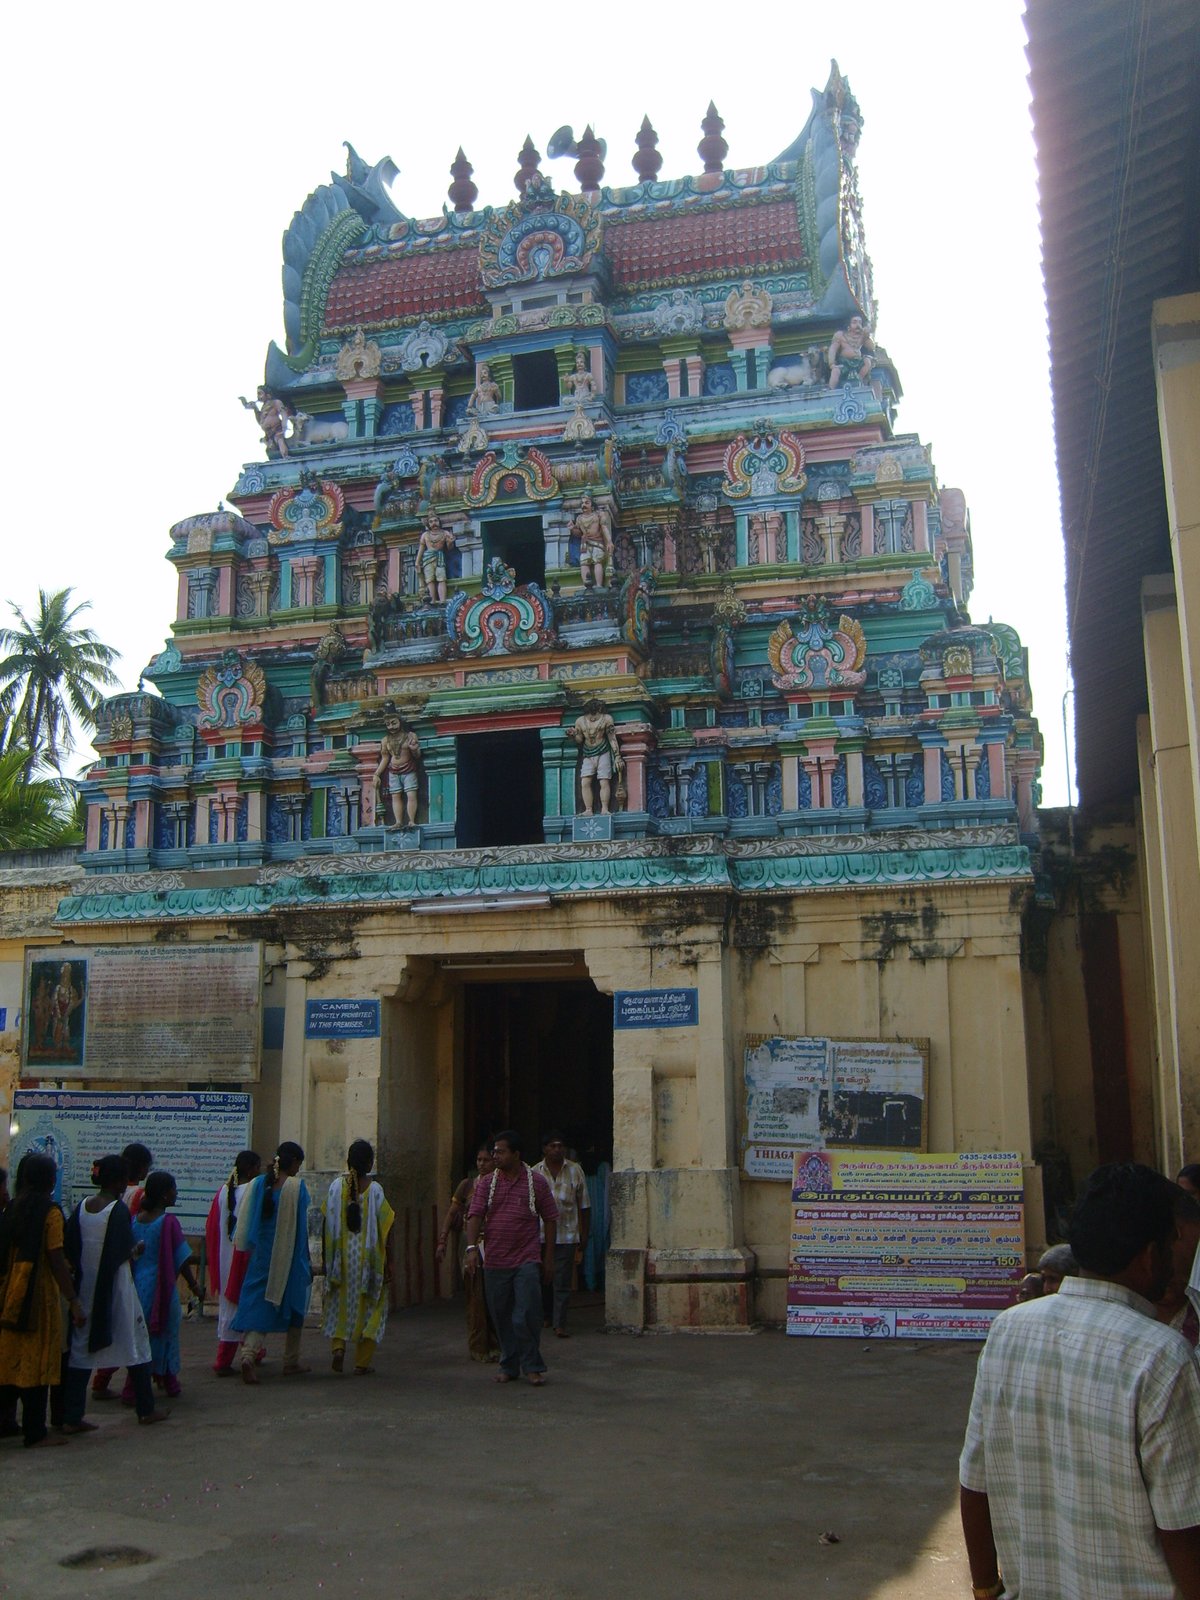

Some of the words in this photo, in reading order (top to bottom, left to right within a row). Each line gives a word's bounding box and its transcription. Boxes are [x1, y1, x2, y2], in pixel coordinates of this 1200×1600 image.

[621, 1004, 666, 1015] புகைப்படம்
[309, 1021, 317, 1029] IN
[206, 1095, 223, 1103] 04364
[227, 1095, 248, 1103] 235002
[754, 1149, 797, 1159] THIAGA
[839, 1162, 884, 1171] அருள்மிகு
[960, 1161, 1021, 1171] திருக்கோயில்
[797, 1191, 962, 1202] இராகுப்பெயர்ச்சி
[968, 1191, 1021, 1203] விழா
[796, 1210, 819, 1219] இராகு
[820, 1210, 848, 1218] பகவான்
[849, 1211, 867, 1219] கும்ப
